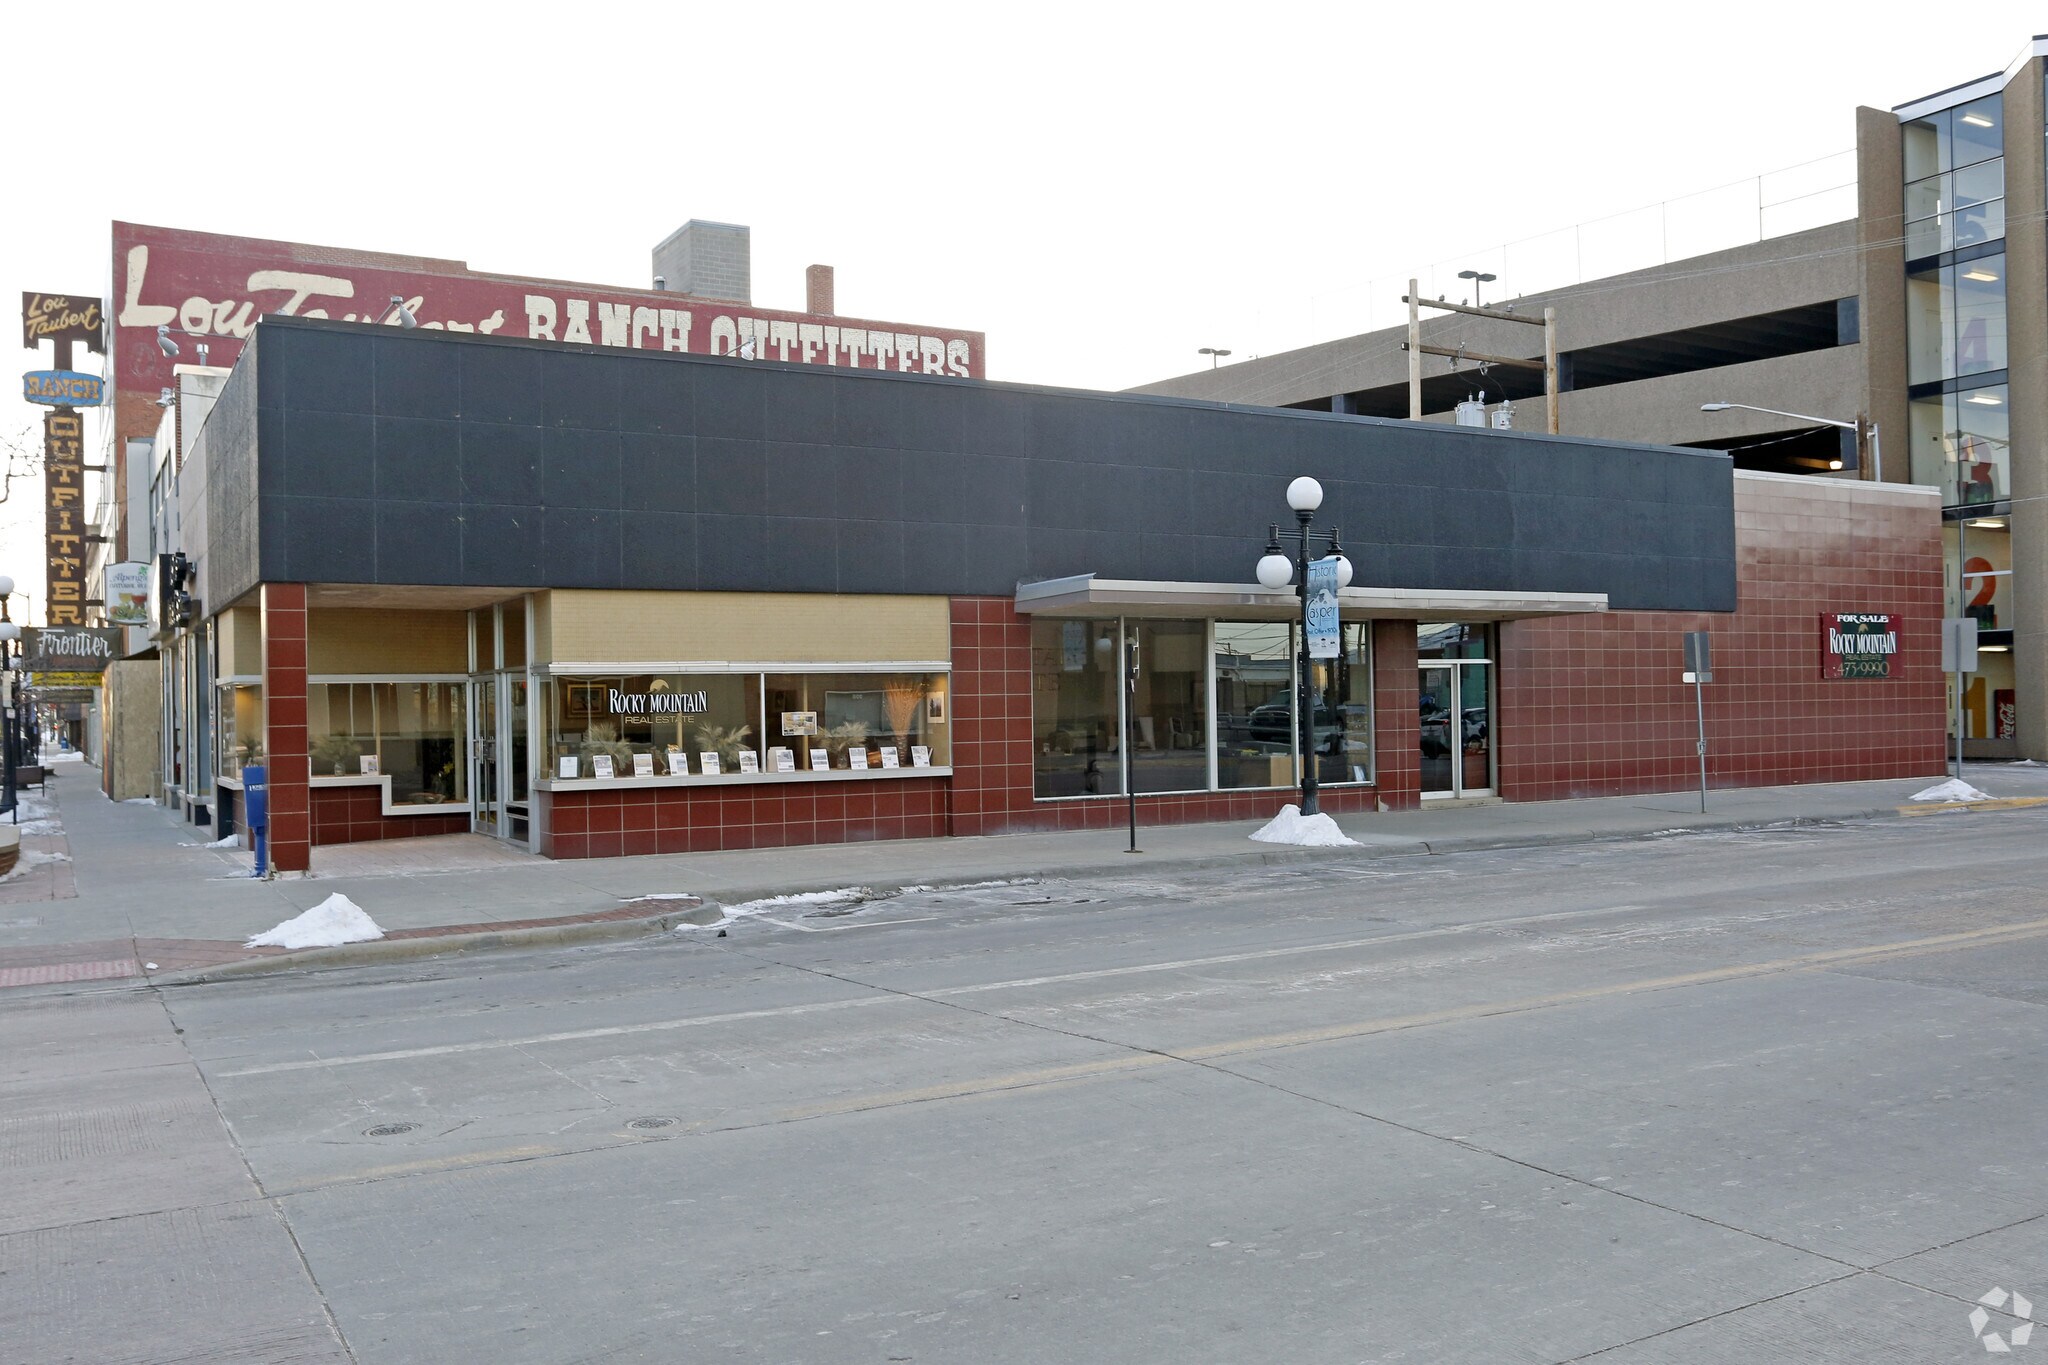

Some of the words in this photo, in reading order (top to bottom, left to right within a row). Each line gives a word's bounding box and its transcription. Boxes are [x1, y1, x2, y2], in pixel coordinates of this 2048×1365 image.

[27, 294, 69, 318] Lou
[119, 244, 257, 337] Lou
[524, 294, 692, 353] RANCH
[710, 315, 970, 379] OUTFITTERS
[26, 304, 99, 338] Taubert
[27, 376, 99, 400] RANCH
[1307, 599, 1336, 627] Casper
[1837, 614, 1860, 624] FOR
[1860, 614, 1889, 623] SALE
[37, 628, 112, 658] Frontier
[1829, 627, 1855, 655] ROCKY
[1856, 631, 1896, 654] MOUNTAIN
[609, 688, 647, 714] ROCKY
[649, 690, 708, 713] MOUNTAIN
[624, 716, 653, 724] REAL
[655, 715, 695, 724] ESTATE
